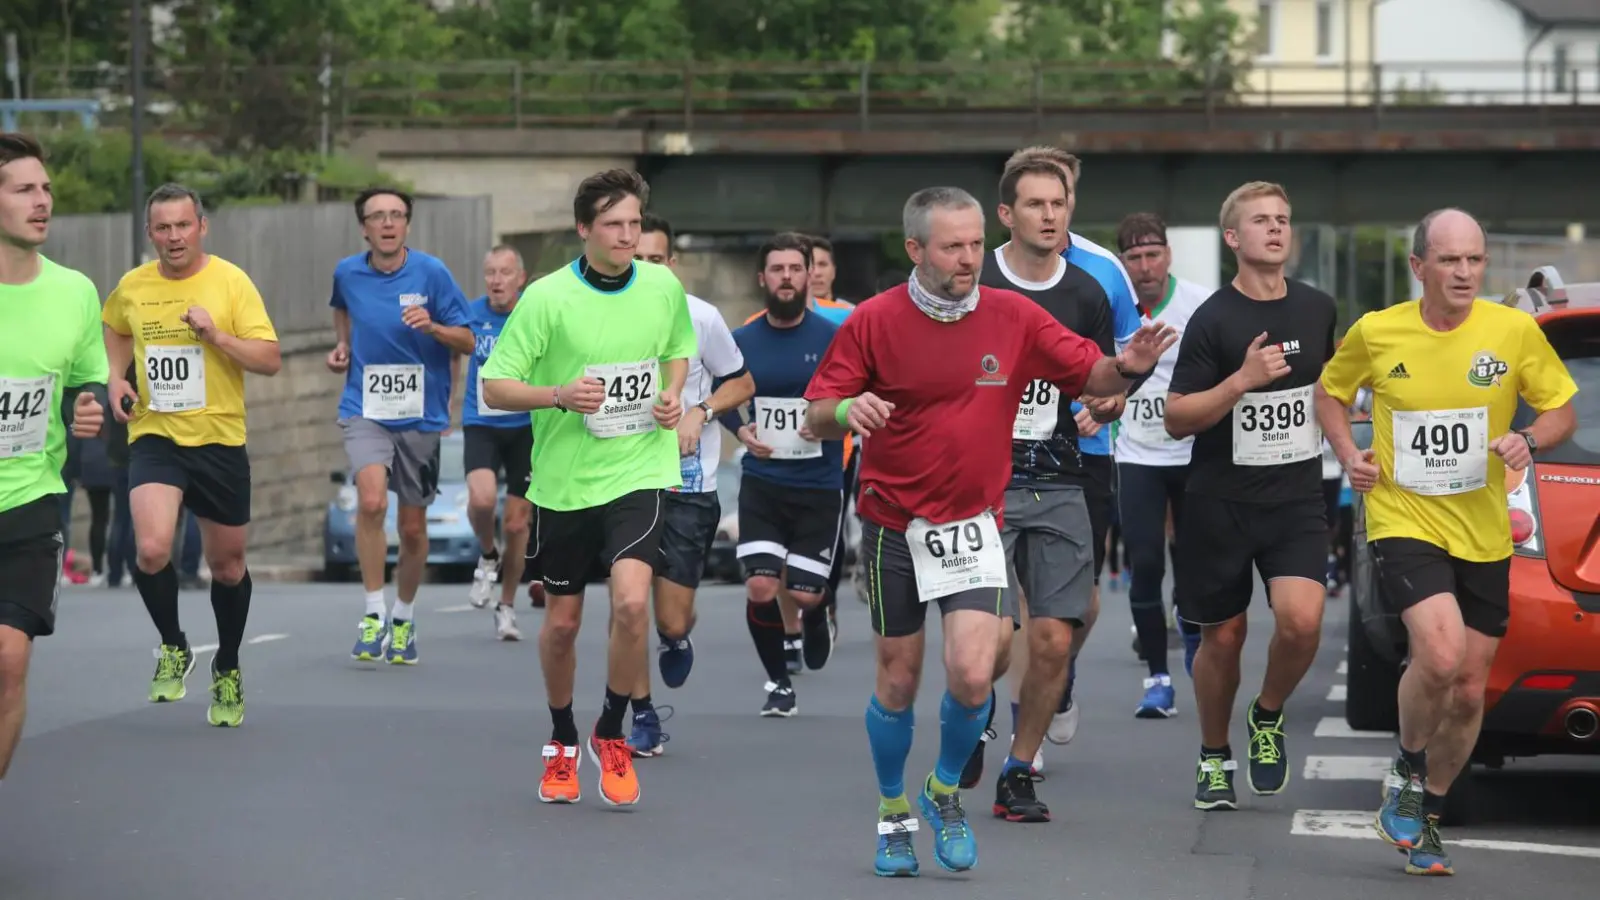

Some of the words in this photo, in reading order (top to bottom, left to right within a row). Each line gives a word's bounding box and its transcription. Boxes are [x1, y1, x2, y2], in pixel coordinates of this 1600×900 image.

[148, 356, 189, 381] 300
[153, 382, 184, 391] Michael
[369, 373, 418, 393] 2954
[0, 388, 46, 421] 442
[604, 402, 642, 414] Sebastian
[1016, 406, 1035, 415] red
[761, 408, 807, 431] 791
[1241, 399, 1306, 432] 3398
[1261, 432, 1290, 442] Stefan
[1411, 422, 1469, 456] 490
[1425, 457, 1458, 468] Marco
[924, 521, 984, 558] 679
[941, 555, 979, 569] Andreas
